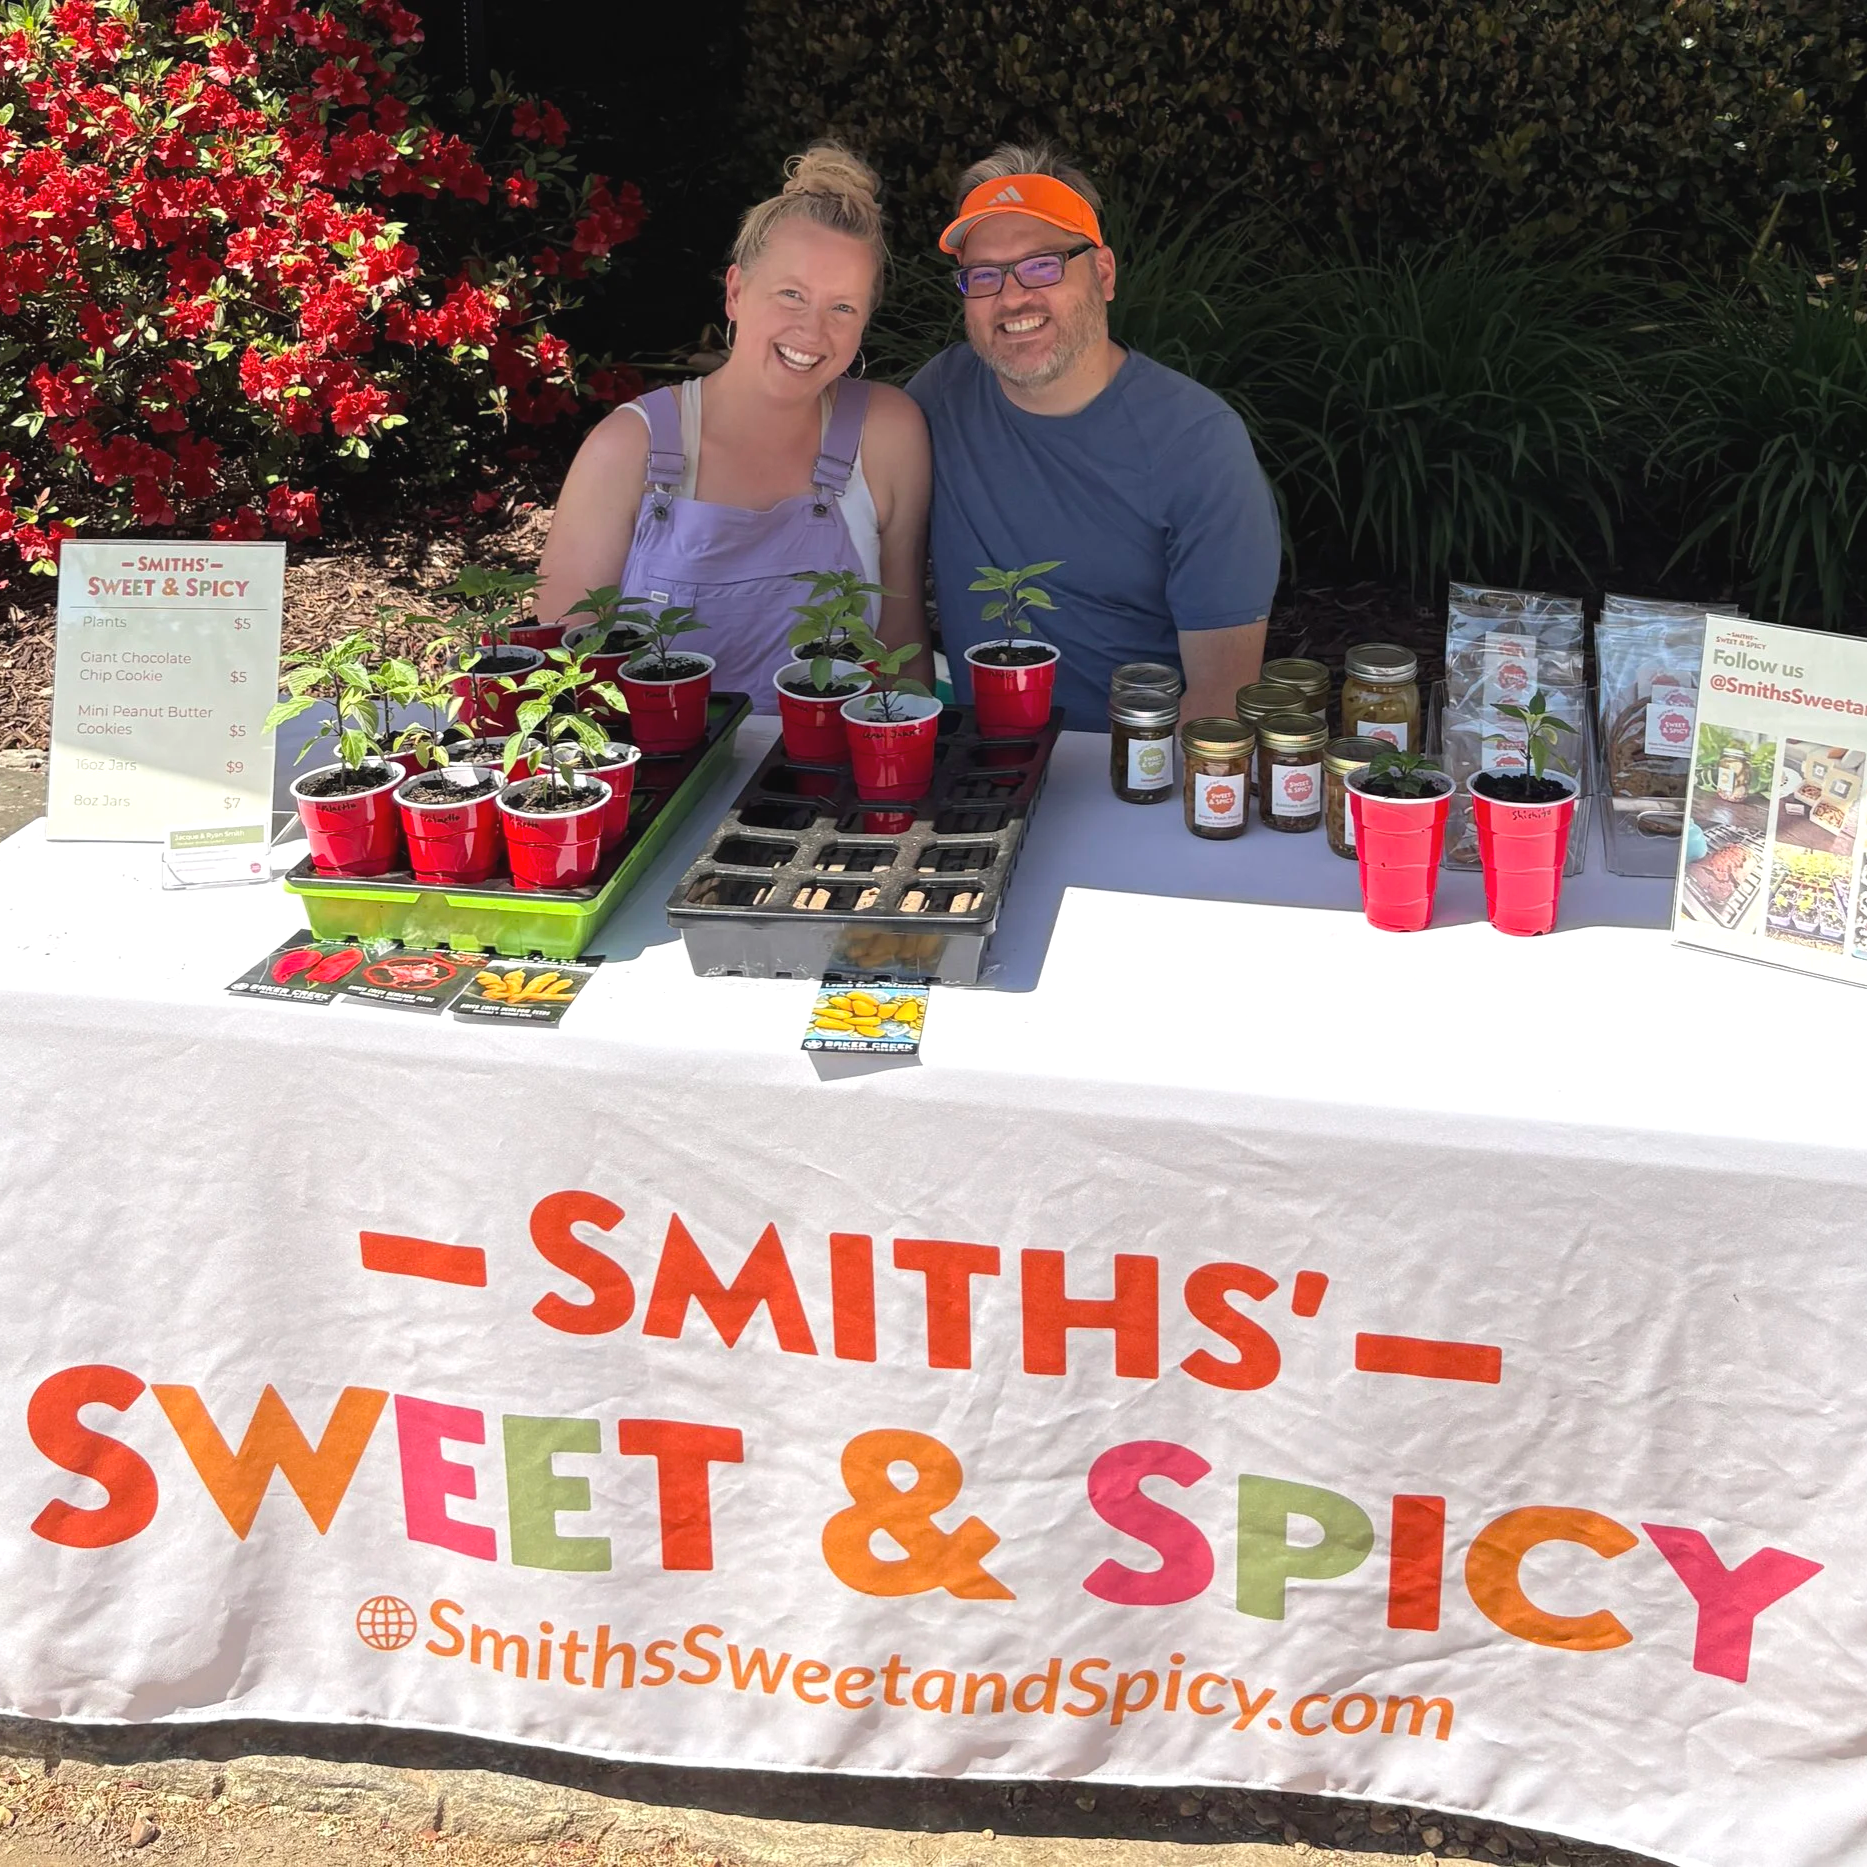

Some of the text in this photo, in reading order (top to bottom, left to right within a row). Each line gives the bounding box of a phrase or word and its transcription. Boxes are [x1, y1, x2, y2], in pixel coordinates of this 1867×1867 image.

[138, 556, 209, 572] SMITHS'
[88, 577, 249, 597] SWEET & SPICY
[83, 616, 251, 630] Plants $5
[1715, 636, 1767, 650] SWEET & SPICY
[80, 652, 191, 665] Giant Chocolate
[1713, 649, 1805, 679] Follow us
[80, 669, 247, 684] Chip Cookie $5
[1710, 674, 1867, 716] @SmithsSweeta
[78, 705, 213, 718] Mini Peanut Butter
[77, 722, 246, 737] Cookies $5
[75, 758, 244, 774] 16oz Jars $9
[74, 795, 241, 810] 8oz Jars $7
[1215, 797, 1234, 805] SPICY
[224, 829, 245, 837] Smith
[824, 1040, 868, 1049] BAKER
[871, 1041, 914, 1050] CREEK
[529, 1190, 1329, 1390] SMITHS'
[27, 1364, 1826, 1683] SWEET & SPICY
[425, 1598, 1455, 1741] SmithsSweetandSpicy.com
